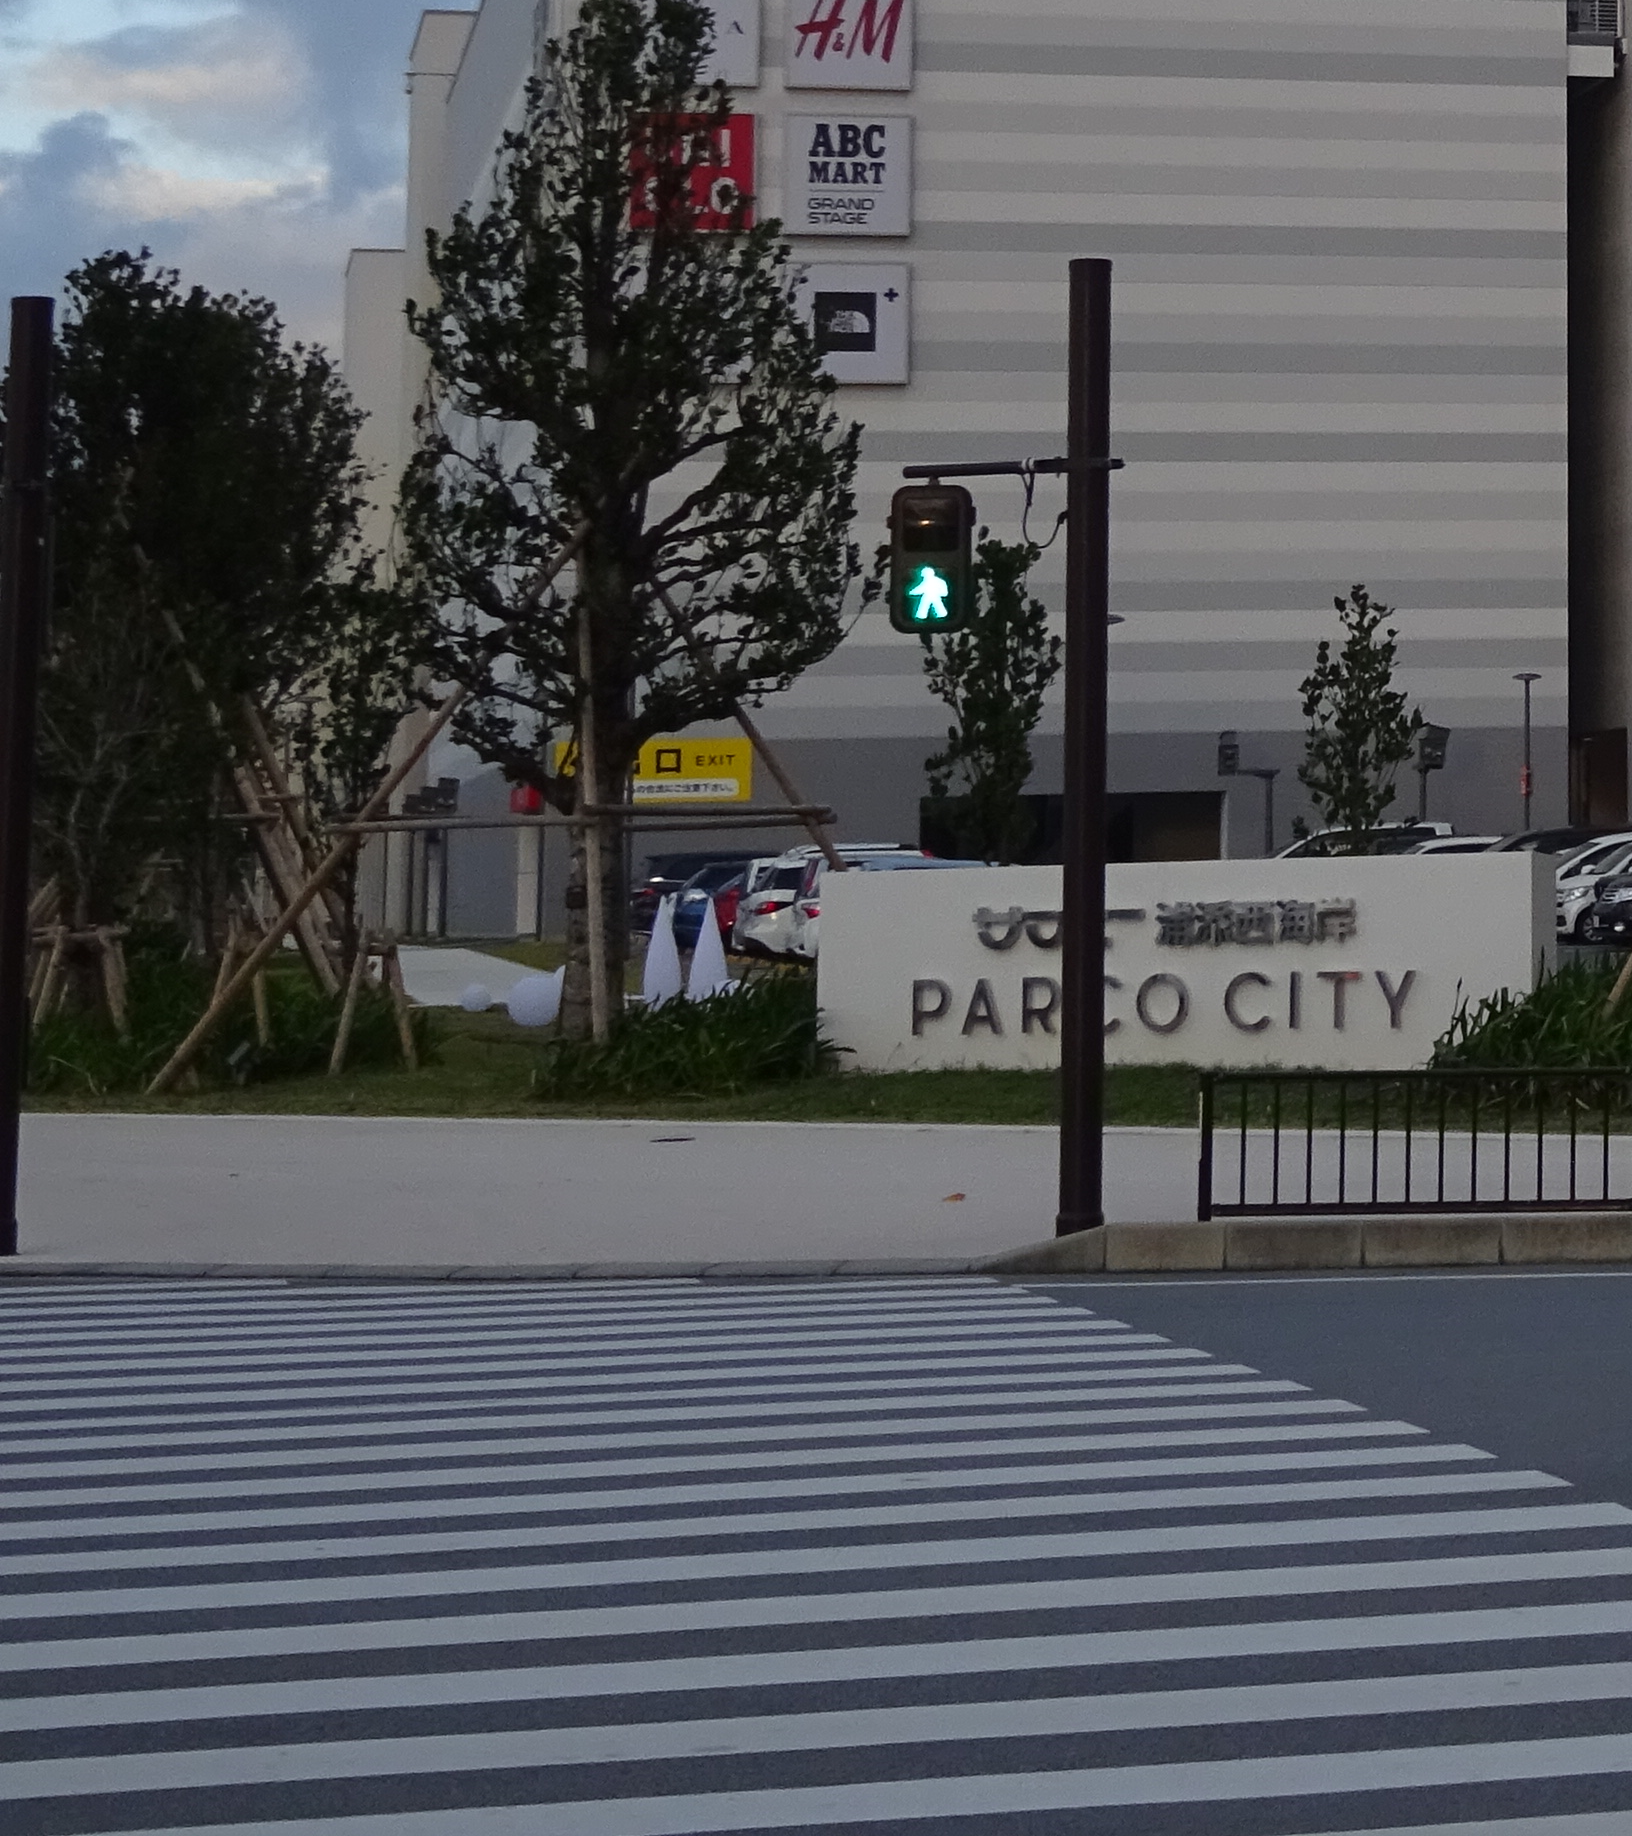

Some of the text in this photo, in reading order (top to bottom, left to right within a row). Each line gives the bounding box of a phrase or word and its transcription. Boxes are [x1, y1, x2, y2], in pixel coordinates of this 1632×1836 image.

[808, 123, 886, 159] ABC
[808, 160, 886, 185] MART
[808, 197, 875, 211] GRAND
[808, 212, 868, 225] STAGE
[695, 754, 736, 767] EXIT
[1223, 969, 1417, 1033] CITY
